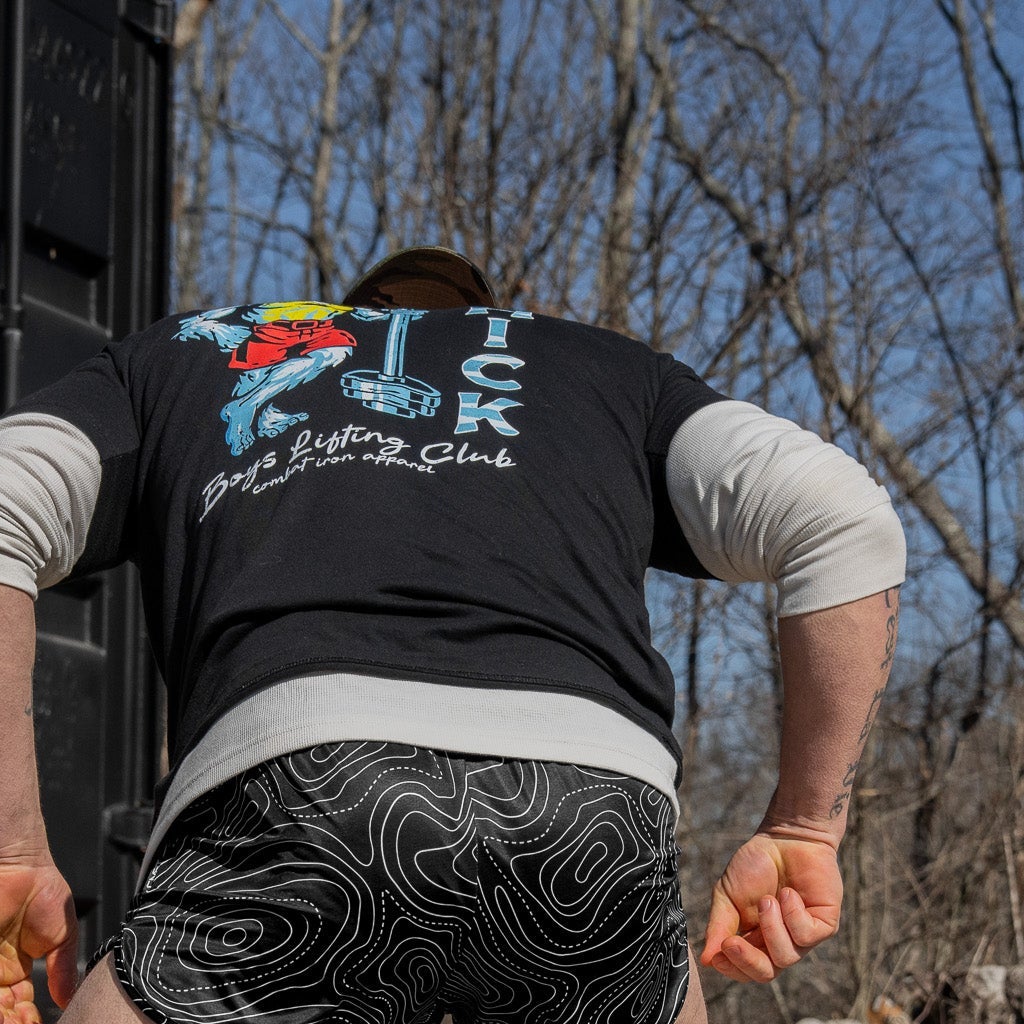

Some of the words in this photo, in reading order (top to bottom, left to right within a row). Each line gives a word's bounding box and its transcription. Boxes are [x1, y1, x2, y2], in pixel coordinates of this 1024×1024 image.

[199, 451, 276, 523] Boys
[289, 424, 410, 463] Lifting
[420, 443, 517, 468] Club
[252, 456, 315, 494] combat
[315, 452, 355, 468] iron
[362, 453, 435, 474] apparel
